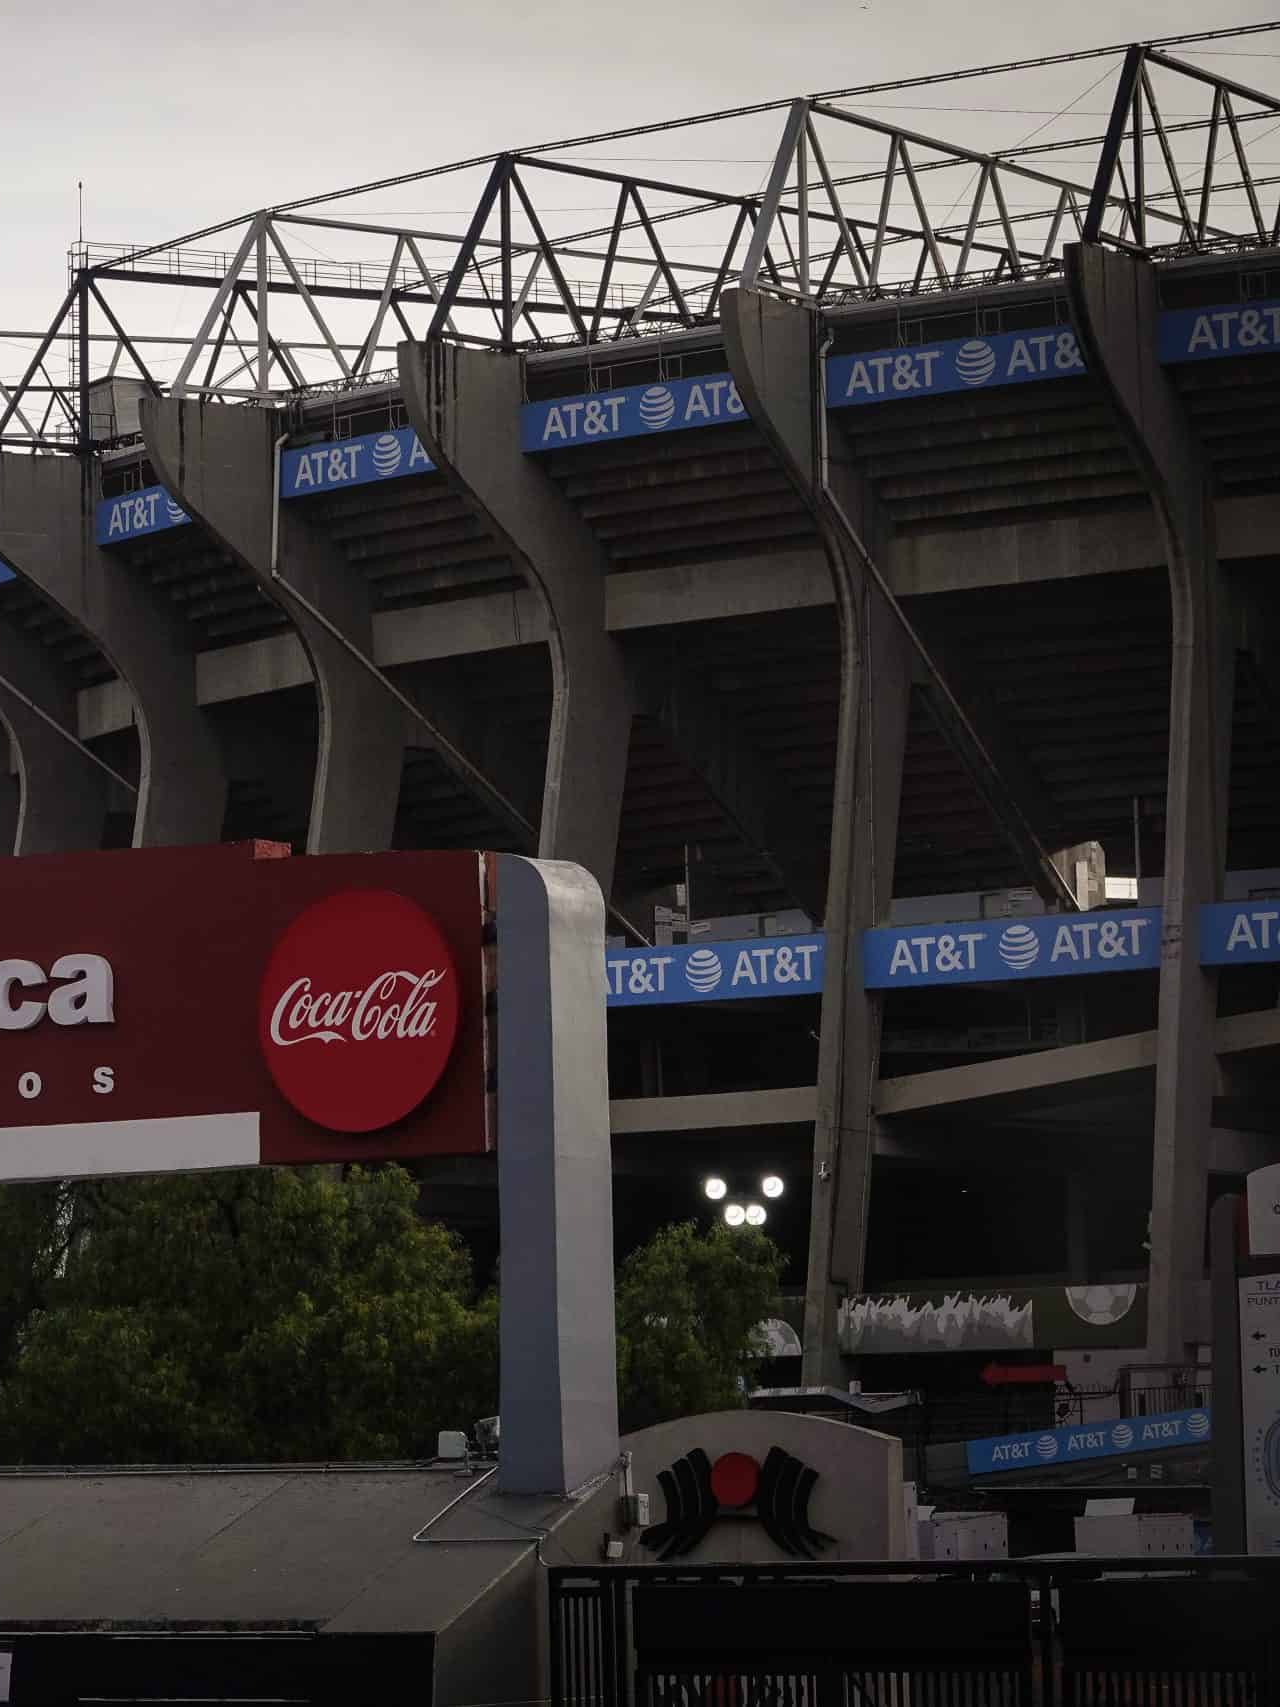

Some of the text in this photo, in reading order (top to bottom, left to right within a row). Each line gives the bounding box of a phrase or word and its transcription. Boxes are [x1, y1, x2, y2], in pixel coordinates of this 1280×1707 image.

[846, 332, 1084, 396] AT&T AT&
[543, 396, 625, 441] AT&T
[294, 444, 363, 489] AT&T
[108, 493, 159, 537] AT&T
[889, 919, 1148, 975] AT&T AT&T
[1226, 912, 1280, 951] AT
[731, 945, 819, 986] AT&T
[270, 968, 447, 1046] Coca-Cola
[991, 1420, 1183, 1462] AT&T AT&T AT&T
